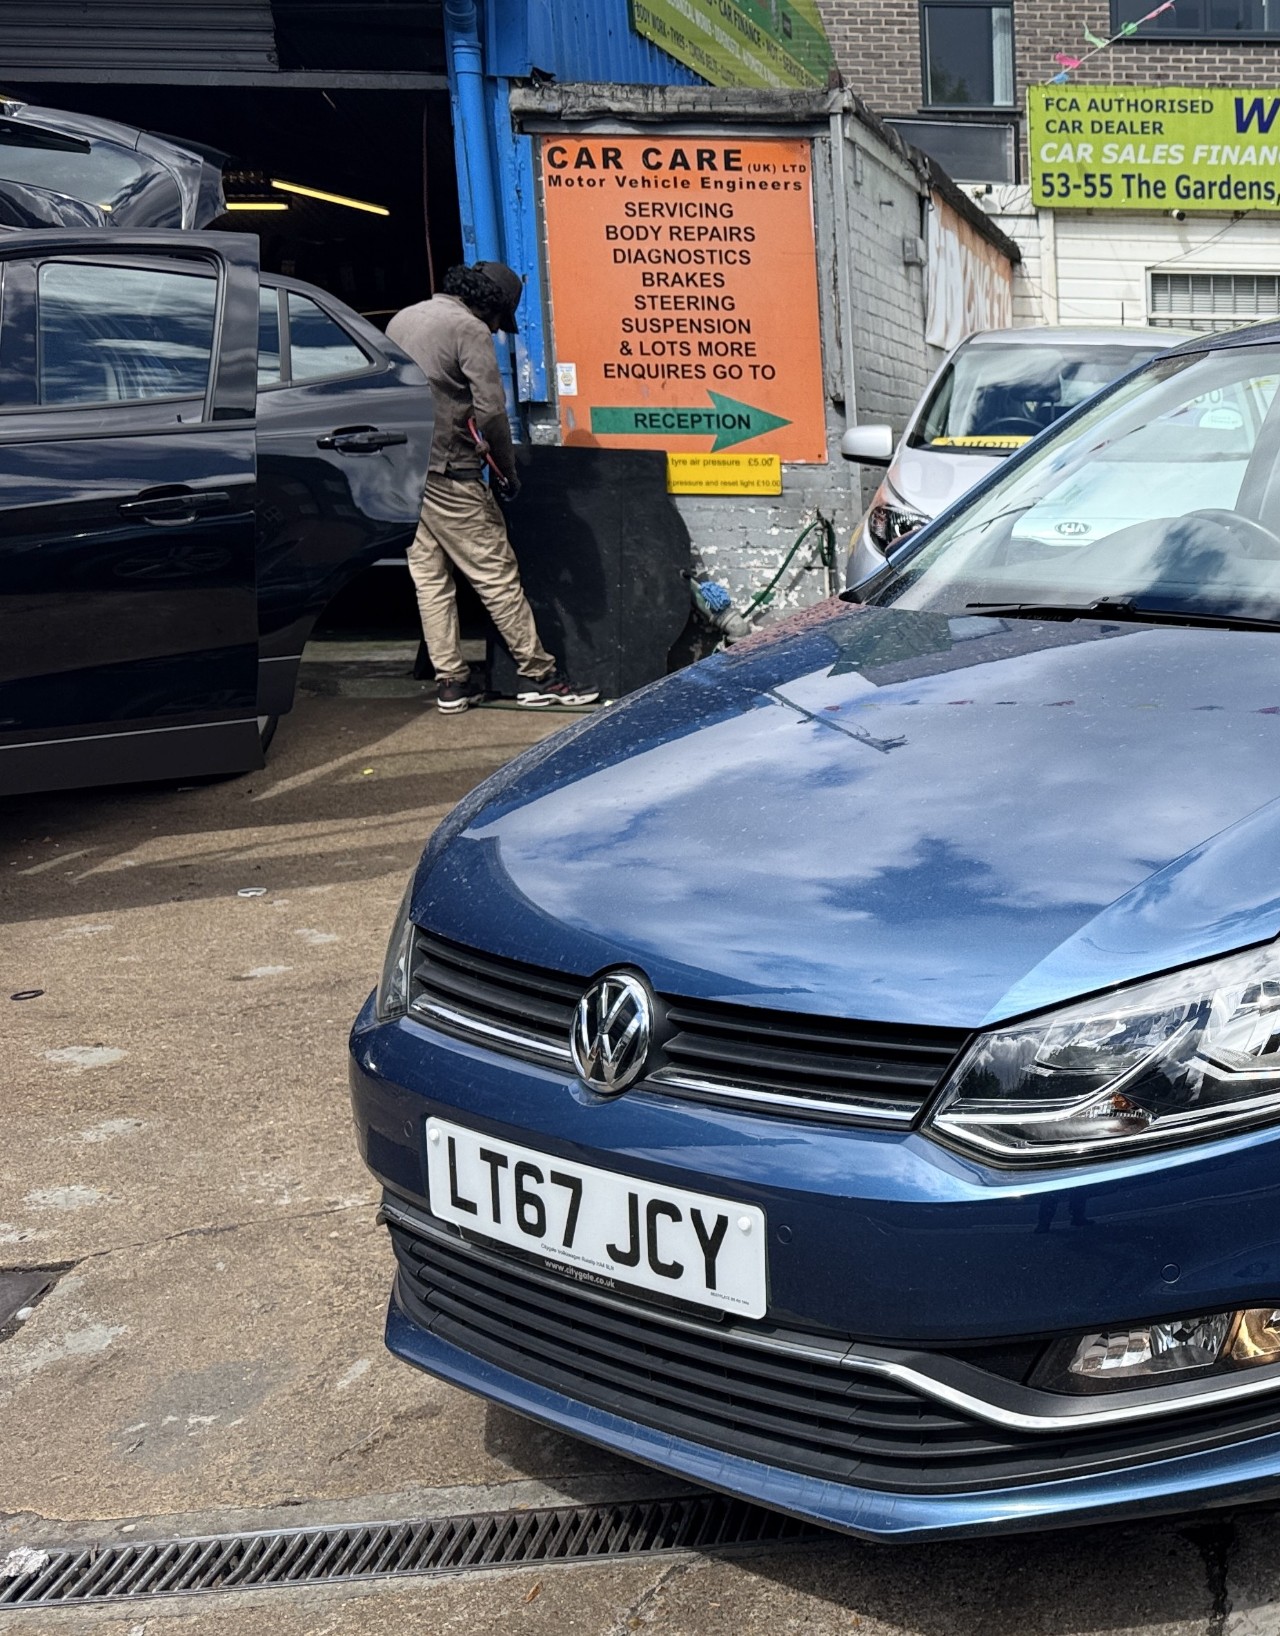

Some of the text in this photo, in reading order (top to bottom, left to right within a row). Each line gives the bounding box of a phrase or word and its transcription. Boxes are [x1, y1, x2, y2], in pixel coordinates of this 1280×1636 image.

[1045, 98, 1214, 114] FCA AUTHORISED
[1045, 120, 1164, 135] CAR DEALER
[547, 146, 806, 174] CAR CARE (UK) LTD
[1040, 143, 1093, 164] CAR
[1100, 144, 1184, 165] SALES
[548, 175, 802, 192] Motor Vehicle Engineers
[1041, 173, 1112, 198] 53-55
[1122, 174, 1167, 199] The
[624, 202, 734, 218] SERVICING
[606, 226, 756, 242] BODY REPAIRS
[613, 248, 751, 265] DIAGNOSTICS
[642, 272, 724, 288] BRAKES
[634, 295, 736, 312] STEERING
[622, 318, 750, 334] SUSPENSION
[620, 341, 756, 357] & LOTS MORE
[604, 364, 776, 381] ENQUIRES GO TO
[634, 413, 751, 430] RECEPTION
[672, 458, 773, 467] tyre air pressure £5.00
[448, 1136, 728, 1290] LT67 JCY
[544, 1260, 616, 1288] www.citygate.co.uk
